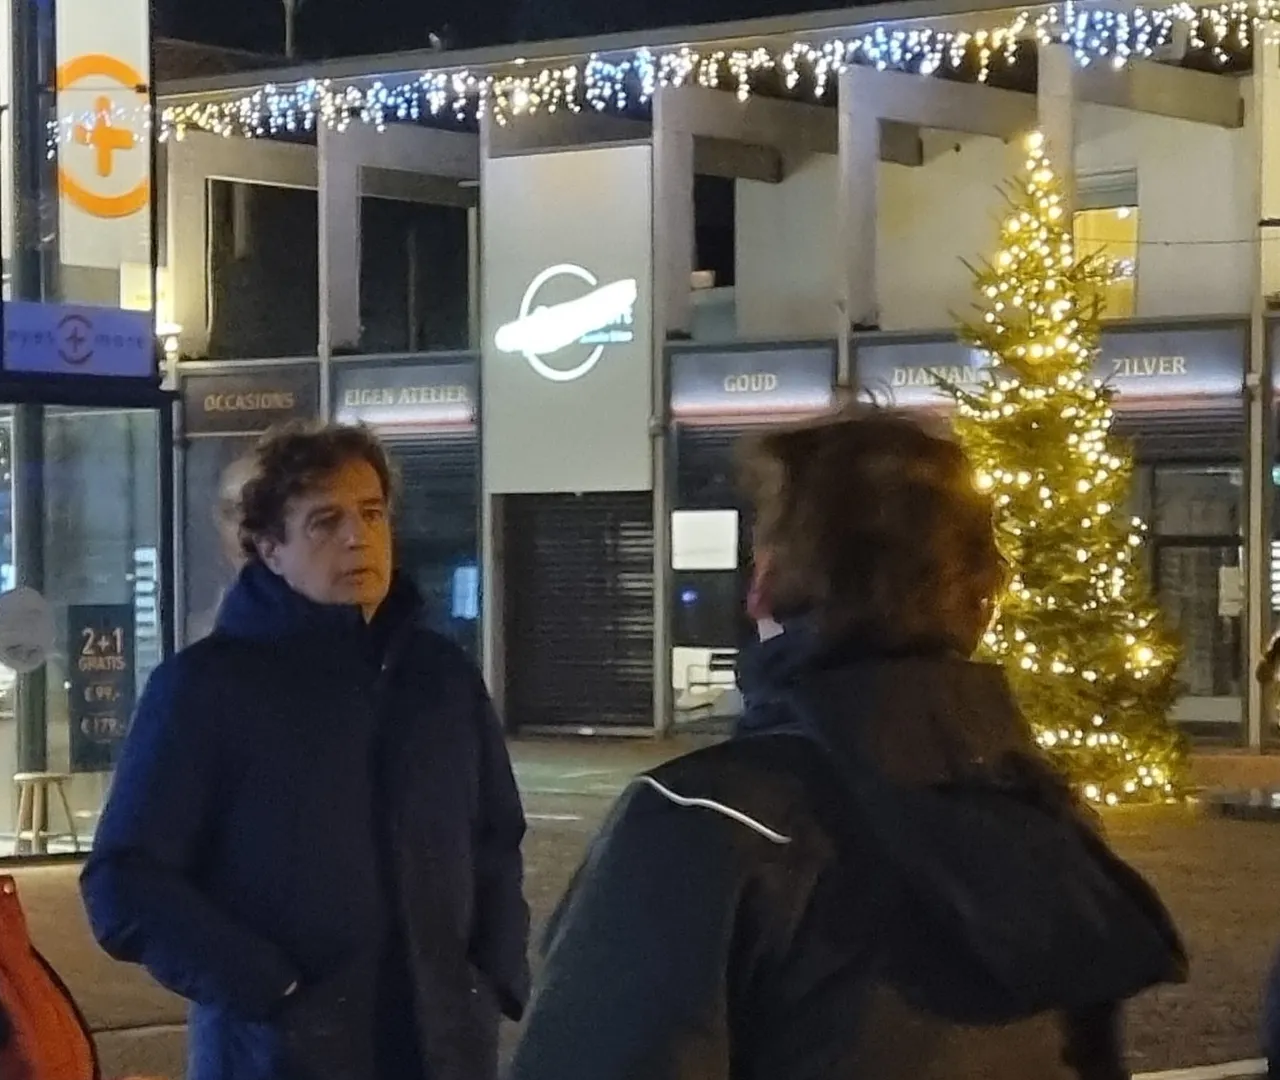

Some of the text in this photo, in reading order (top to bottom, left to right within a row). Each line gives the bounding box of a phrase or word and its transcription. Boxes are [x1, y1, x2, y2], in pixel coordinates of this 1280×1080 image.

[891, 365, 977, 387] DIAMAN
[1111, 355, 1188, 377] ZILVER
[723, 373, 777, 392] GOUD
[203, 392, 294, 412] OCCASIONS
[344, 385, 469, 407] EIGEN ATELIER
[77, 655, 127, 672] GRATIS
